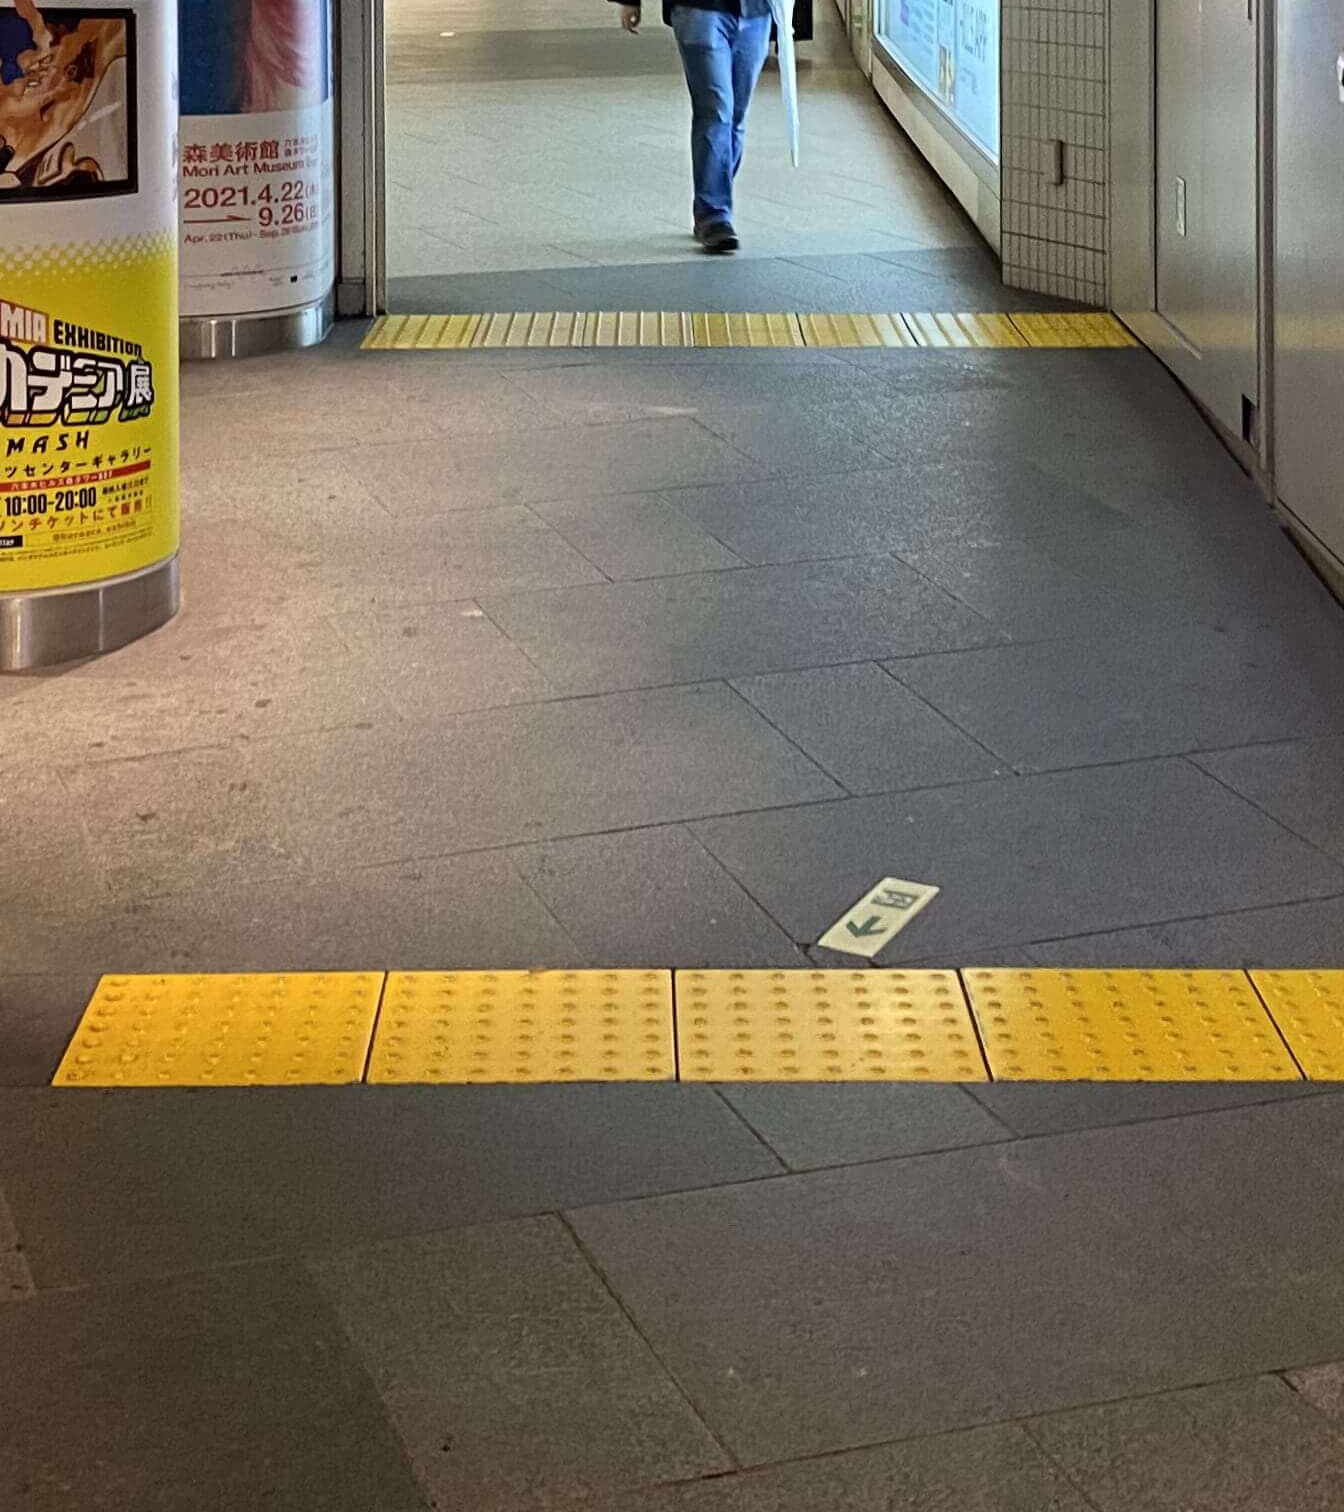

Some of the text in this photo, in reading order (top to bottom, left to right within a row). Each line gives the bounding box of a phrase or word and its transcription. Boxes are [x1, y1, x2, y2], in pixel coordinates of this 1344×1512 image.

[182, 140, 280, 164] 森美術館
[182, 164, 220, 178] Mori
[223, 163, 249, 176] Art
[53, 319, 143, 357] EXHIBITION
[4, 485, 98, 518] 10:00-20:00
